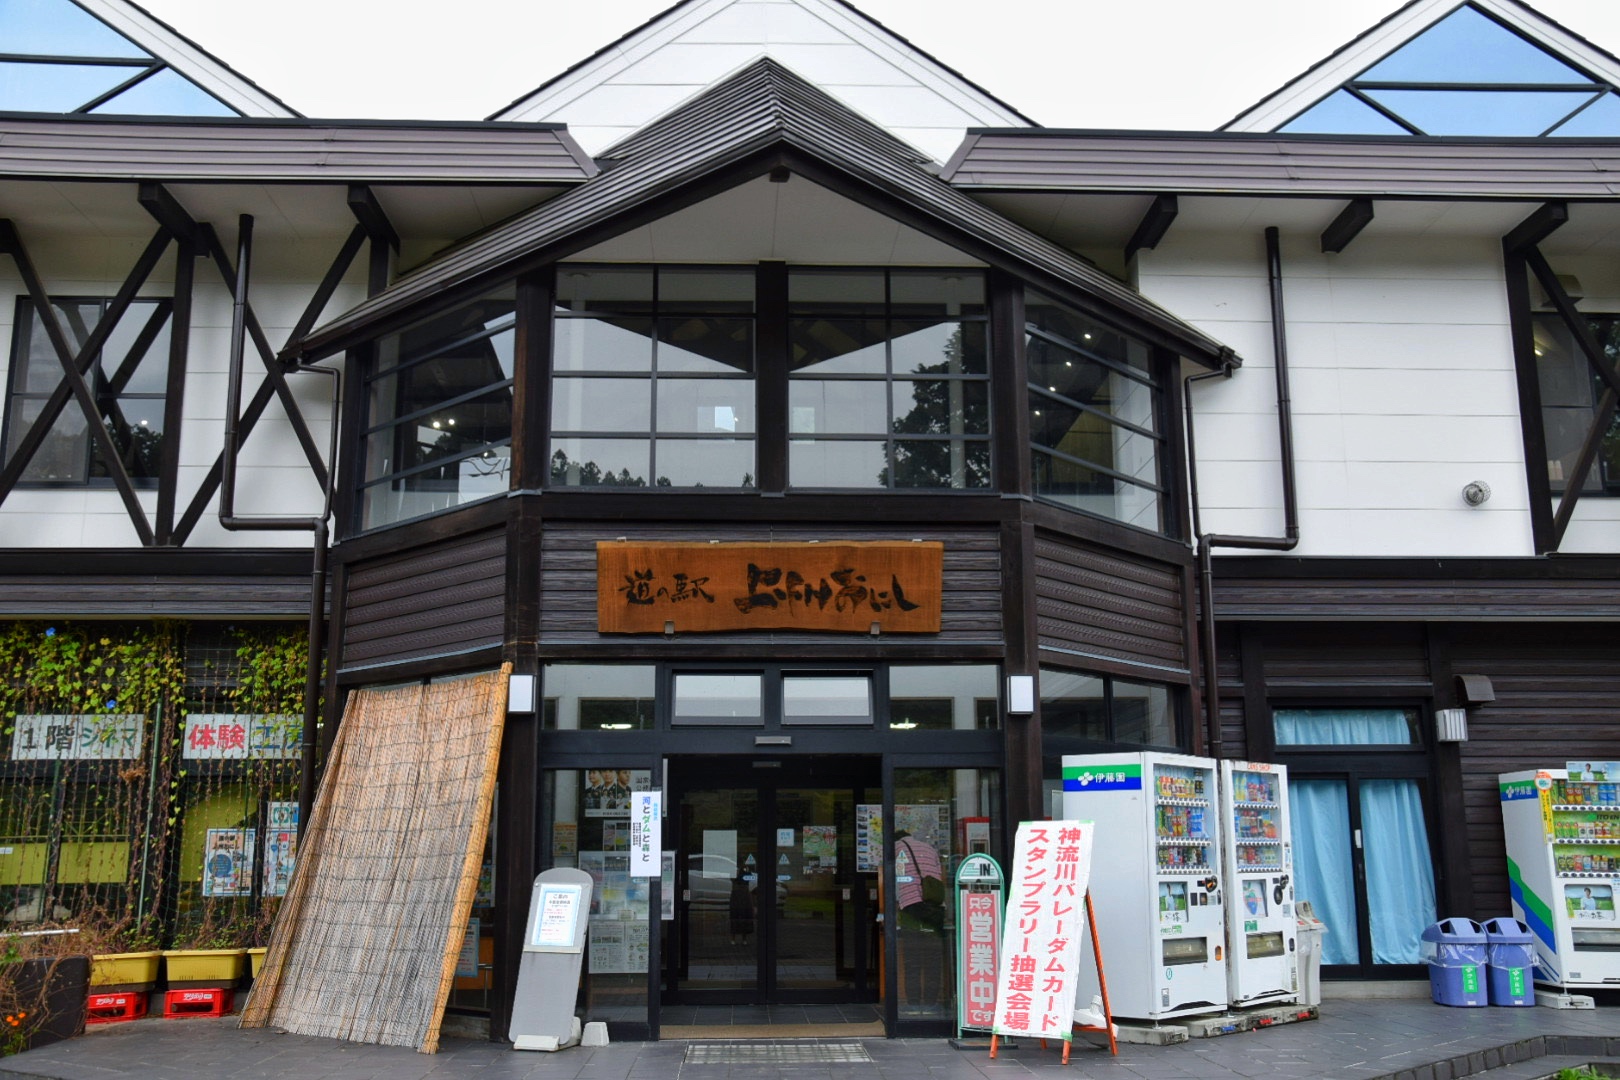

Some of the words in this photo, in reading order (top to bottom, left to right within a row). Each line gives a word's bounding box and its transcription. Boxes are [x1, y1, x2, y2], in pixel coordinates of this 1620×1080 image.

[618, 568, 715, 606] 道の駅
[1095, 771, 1126, 783] 伊藤園
[979, 863, 991, 876] IN
[969, 896, 993, 910] 只今
[1003, 828, 1050, 1031] スタンプラリー抽選会場
[1041, 827, 1081, 1032] 神流川バレーダムカード
[969, 910, 994, 1008] 営業中
[970, 1010, 994, 1023] です
